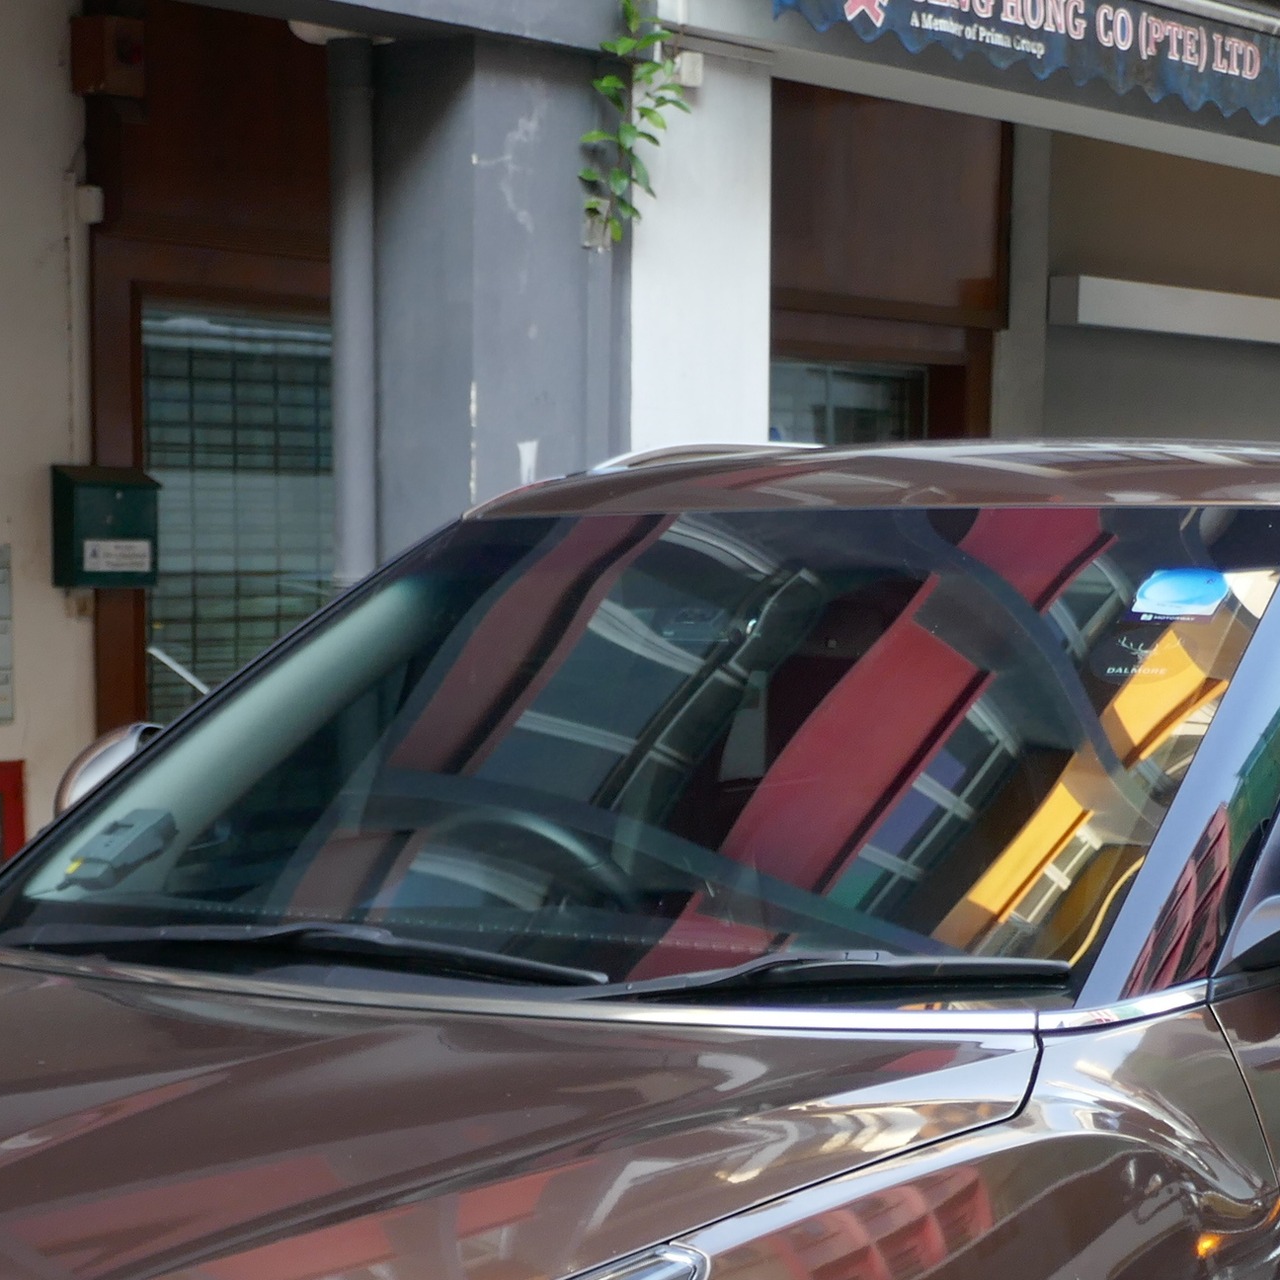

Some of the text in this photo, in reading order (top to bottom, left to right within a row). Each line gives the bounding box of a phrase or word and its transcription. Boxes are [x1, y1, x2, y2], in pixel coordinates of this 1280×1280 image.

[910, 10, 1046, 60] A Member of Prima Group
[1095, 4, 1133, 51] CO
[1138, 12, 1208, 73] (PTE)
[1212, 33, 1261, 80] LTD
